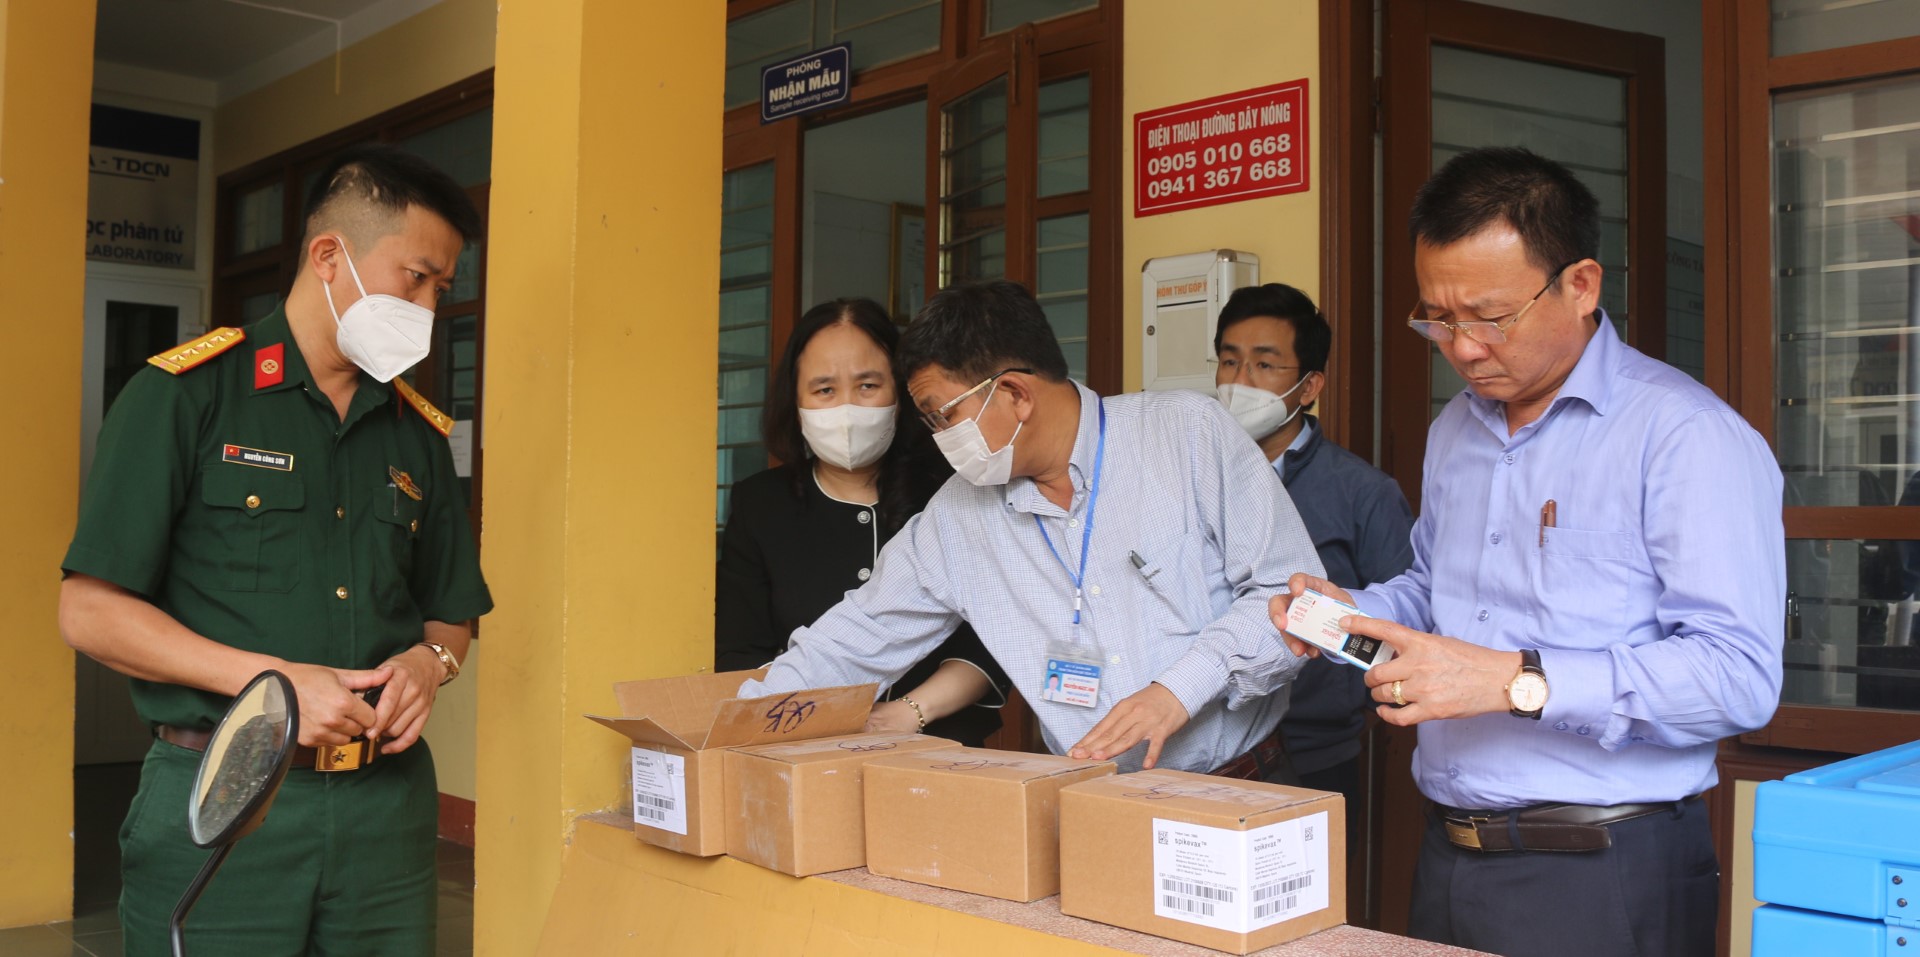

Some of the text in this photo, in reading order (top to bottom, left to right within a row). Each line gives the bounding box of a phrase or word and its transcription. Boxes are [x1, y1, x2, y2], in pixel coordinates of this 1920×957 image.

[786, 59, 821, 78] PHÒNG
[769, 68, 840, 102] NHẬN MẪU
[770, 88, 839, 112] Sample receiving room
[1148, 101, 1291, 151] ĐIỆN THOẠI ĐƯỜNG DÂY NÓNG
[112, 156, 170, 177] TDCN
[1147, 133, 1291, 176] 0905 010 668
[1147, 158, 1292, 199] 0941 367 668
[110, 218, 159, 241] phân
[164, 224, 183, 244] tử
[86, 244, 183, 263] ABORATORY
